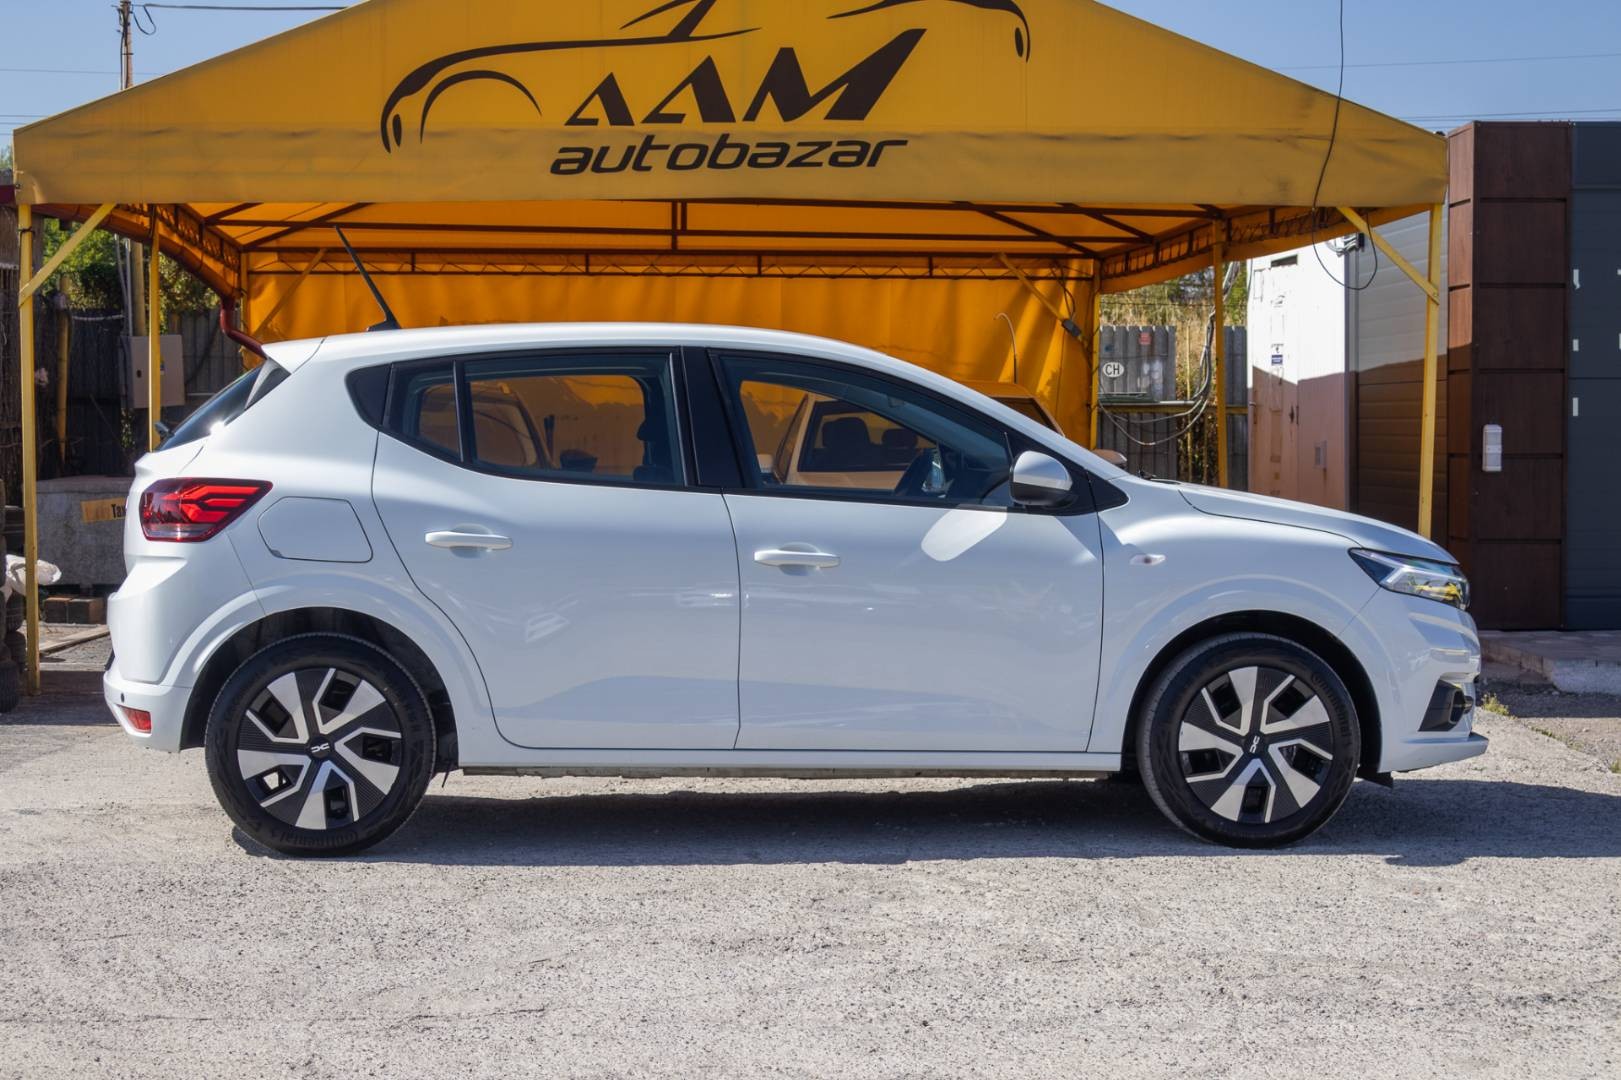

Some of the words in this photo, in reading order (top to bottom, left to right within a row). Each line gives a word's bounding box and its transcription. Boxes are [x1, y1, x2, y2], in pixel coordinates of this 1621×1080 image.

[564, 28, 927, 126] AAM
[549, 133, 908, 175] autobazar
[1105, 364, 1120, 376] CH
